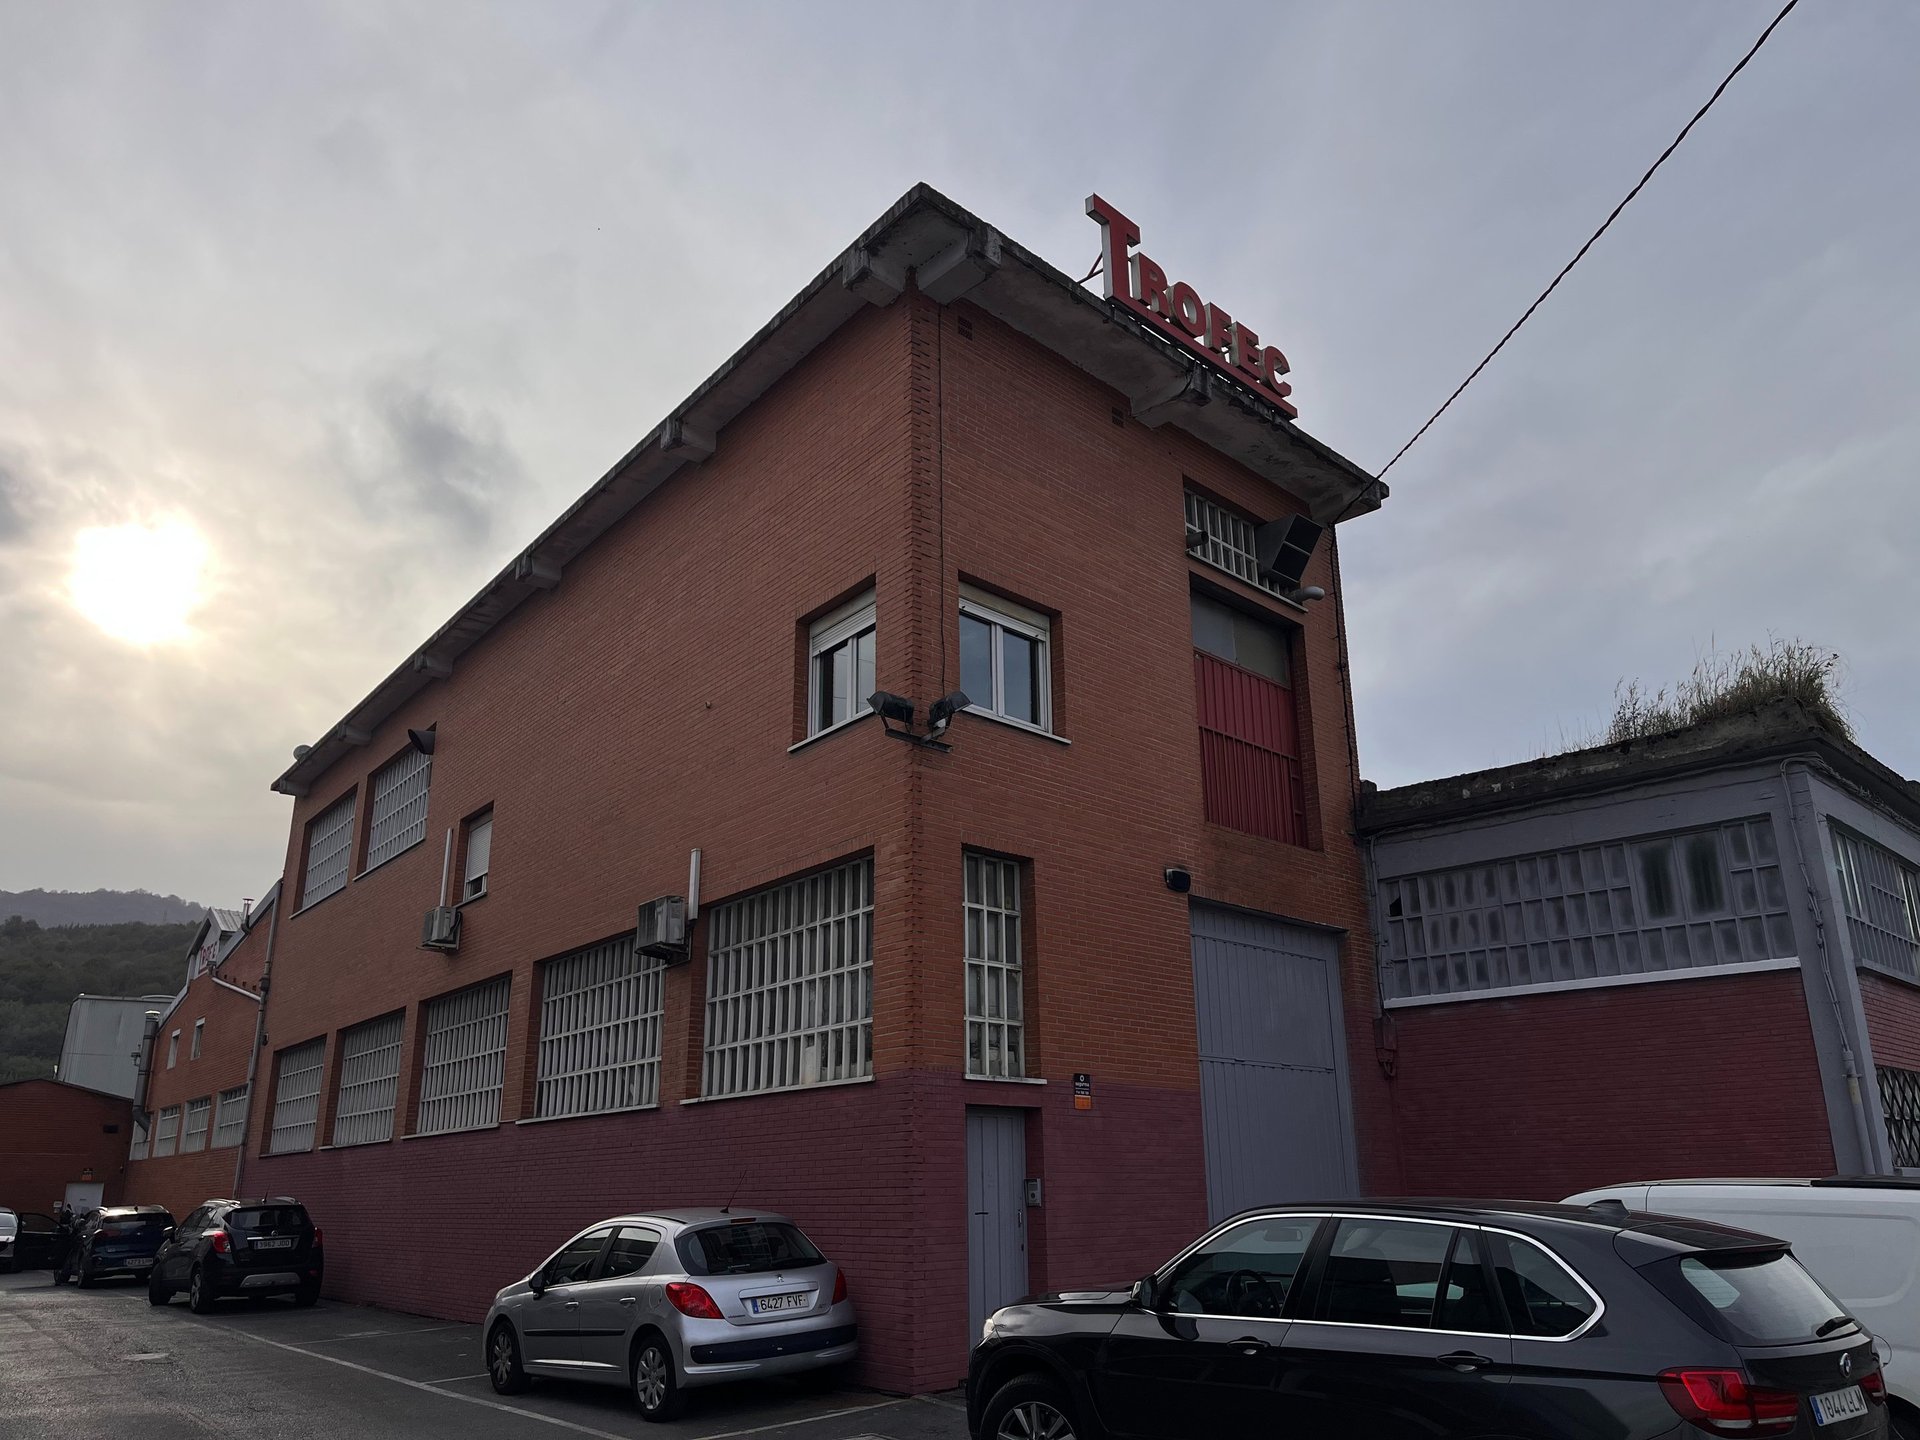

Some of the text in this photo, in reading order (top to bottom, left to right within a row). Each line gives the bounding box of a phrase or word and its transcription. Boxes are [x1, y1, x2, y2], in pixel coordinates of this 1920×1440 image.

[1085, 192, 1292, 399] TROFEC
[761, 1294, 803, 1310] 6427 FVF
[1821, 1394, 1847, 1419] 1044
